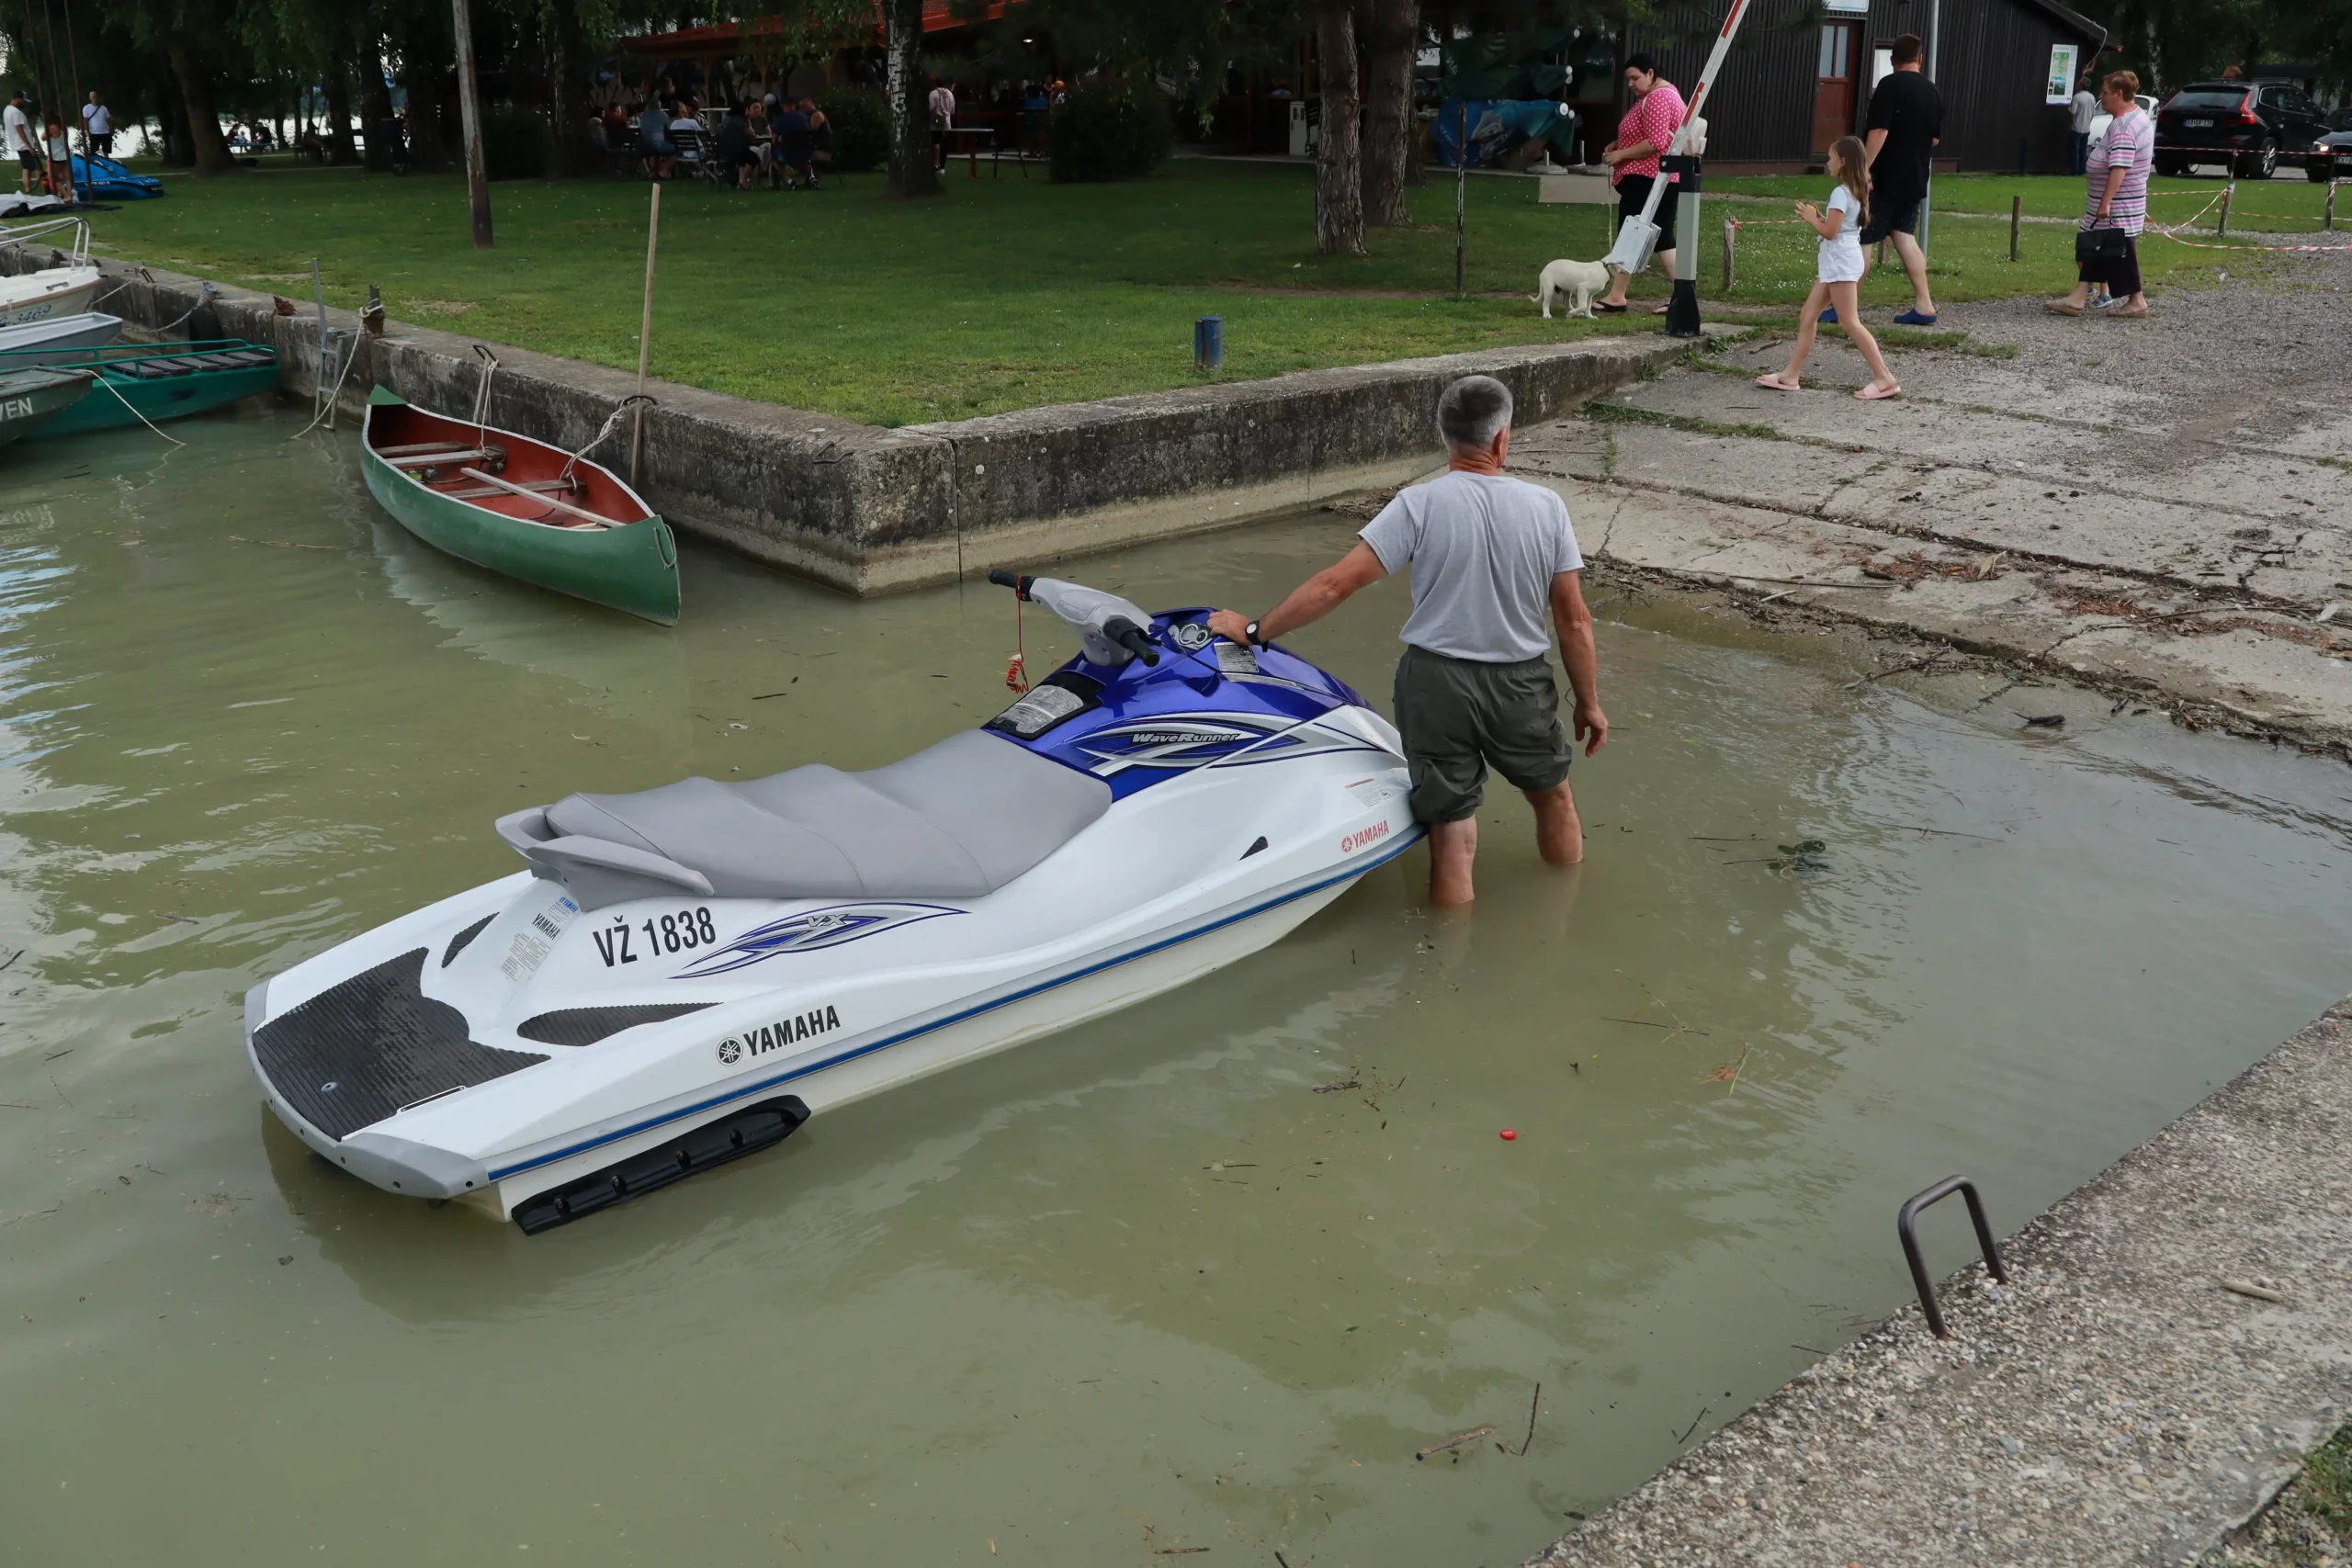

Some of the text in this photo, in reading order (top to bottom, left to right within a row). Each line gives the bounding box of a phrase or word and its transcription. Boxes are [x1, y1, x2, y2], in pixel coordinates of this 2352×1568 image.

[17, 304, 51, 321] 3469
[1132, 733, 1238, 743] WaveRunner
[1353, 820, 1389, 848] YAMAHA
[532, 913, 561, 941] YAMAHA
[806, 914, 850, 927] VX
[593, 915, 638, 967] VŽ
[642, 907, 716, 956] 1838
[743, 1005, 841, 1056] YAMAHA
